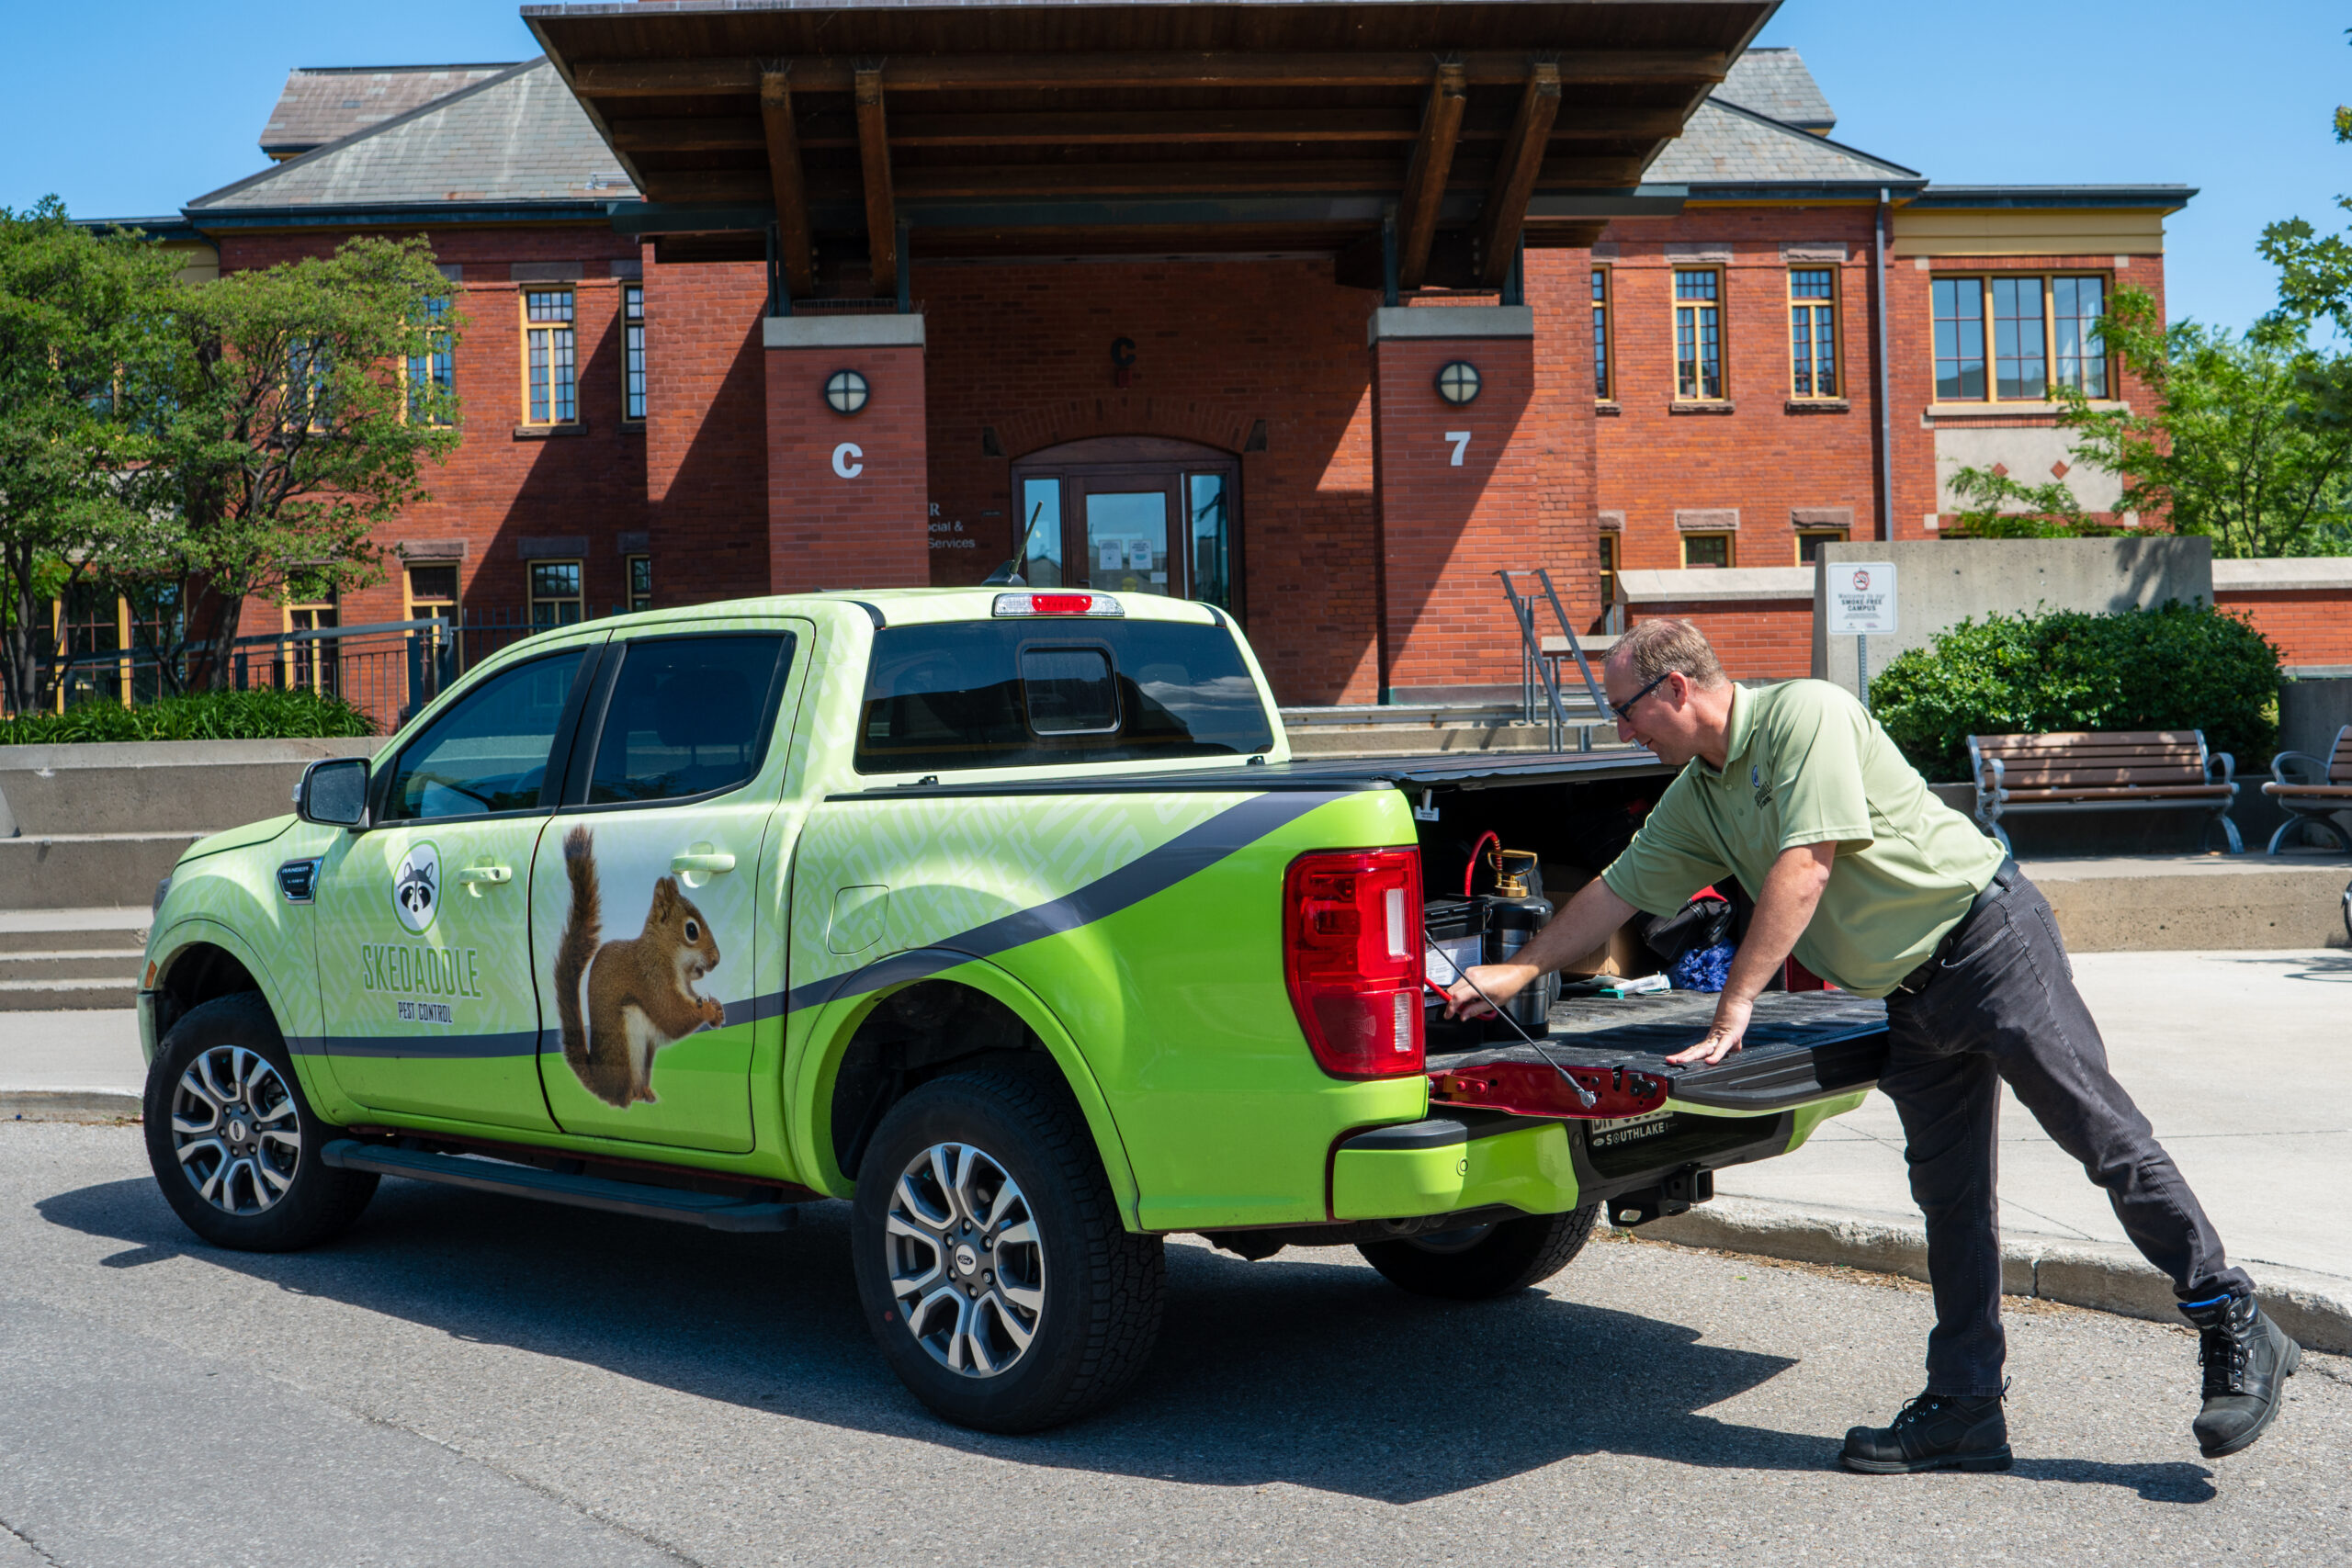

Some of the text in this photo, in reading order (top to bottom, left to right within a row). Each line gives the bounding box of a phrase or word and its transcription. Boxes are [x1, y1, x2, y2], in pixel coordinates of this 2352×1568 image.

[1110, 337, 1136, 367] C
[831, 442, 864, 479] C
[1445, 431, 1471, 466] 7
[954, 520, 964, 532] &
[928, 537, 976, 549] Services
[362, 944, 482, 998] SKEDADDLE
[398, 1001, 453, 1023] PEST CONTROL
[1605, 1122, 1665, 1145] SOUTHLAKE
